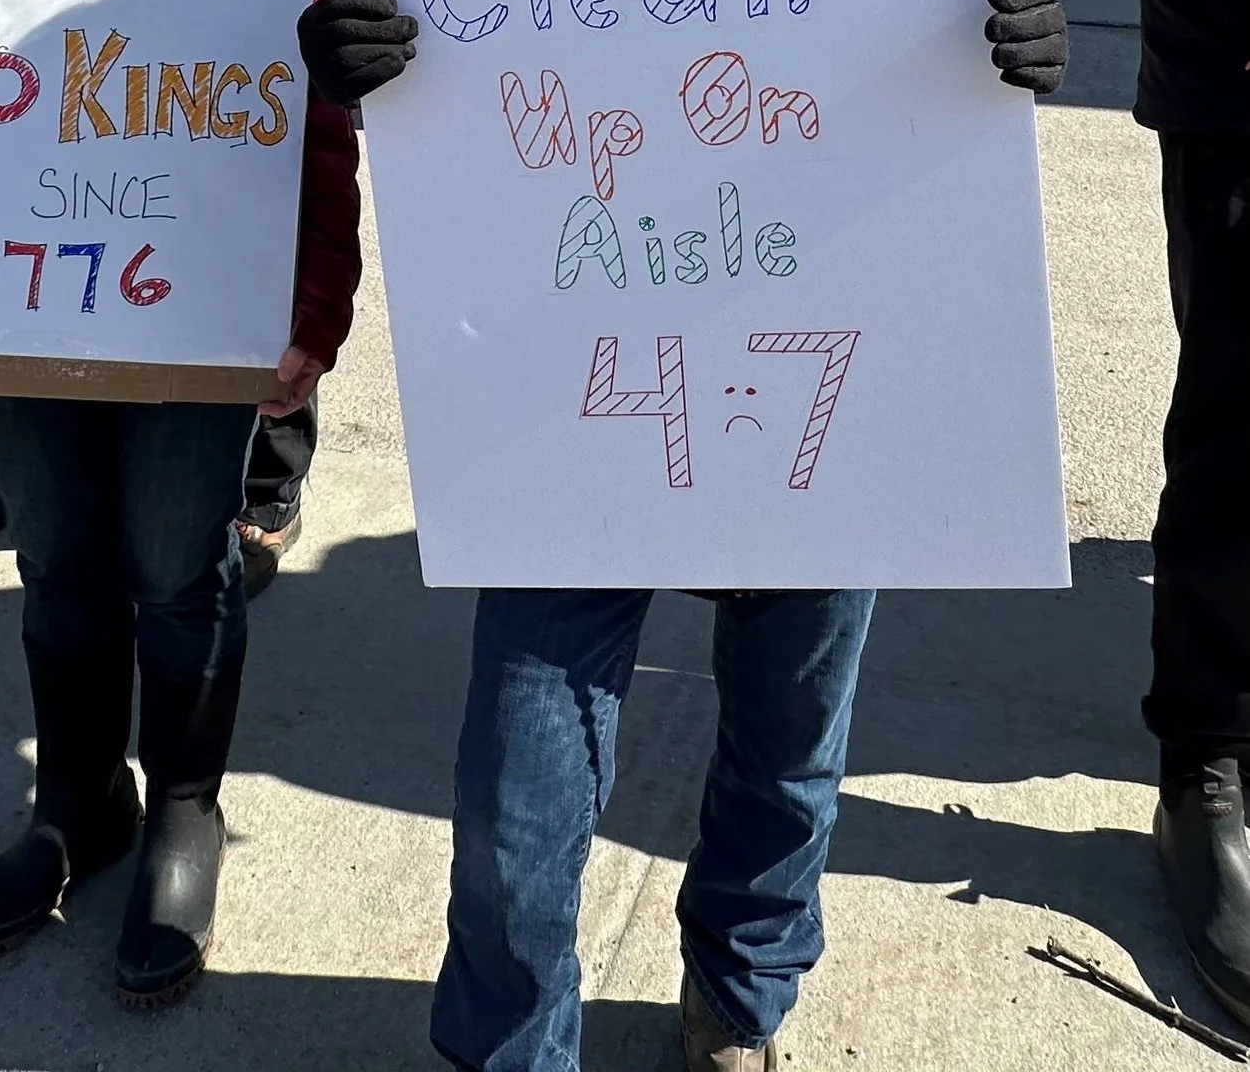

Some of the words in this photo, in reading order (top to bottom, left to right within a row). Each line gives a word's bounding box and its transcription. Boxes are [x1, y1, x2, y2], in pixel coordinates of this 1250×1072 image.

[58, 28, 295, 147] KINGS
[500, 69, 643, 201] Up
[679, 51, 819, 146] On
[30, 168, 177, 219] SINCE
[555, 181, 797, 290] Aisle
